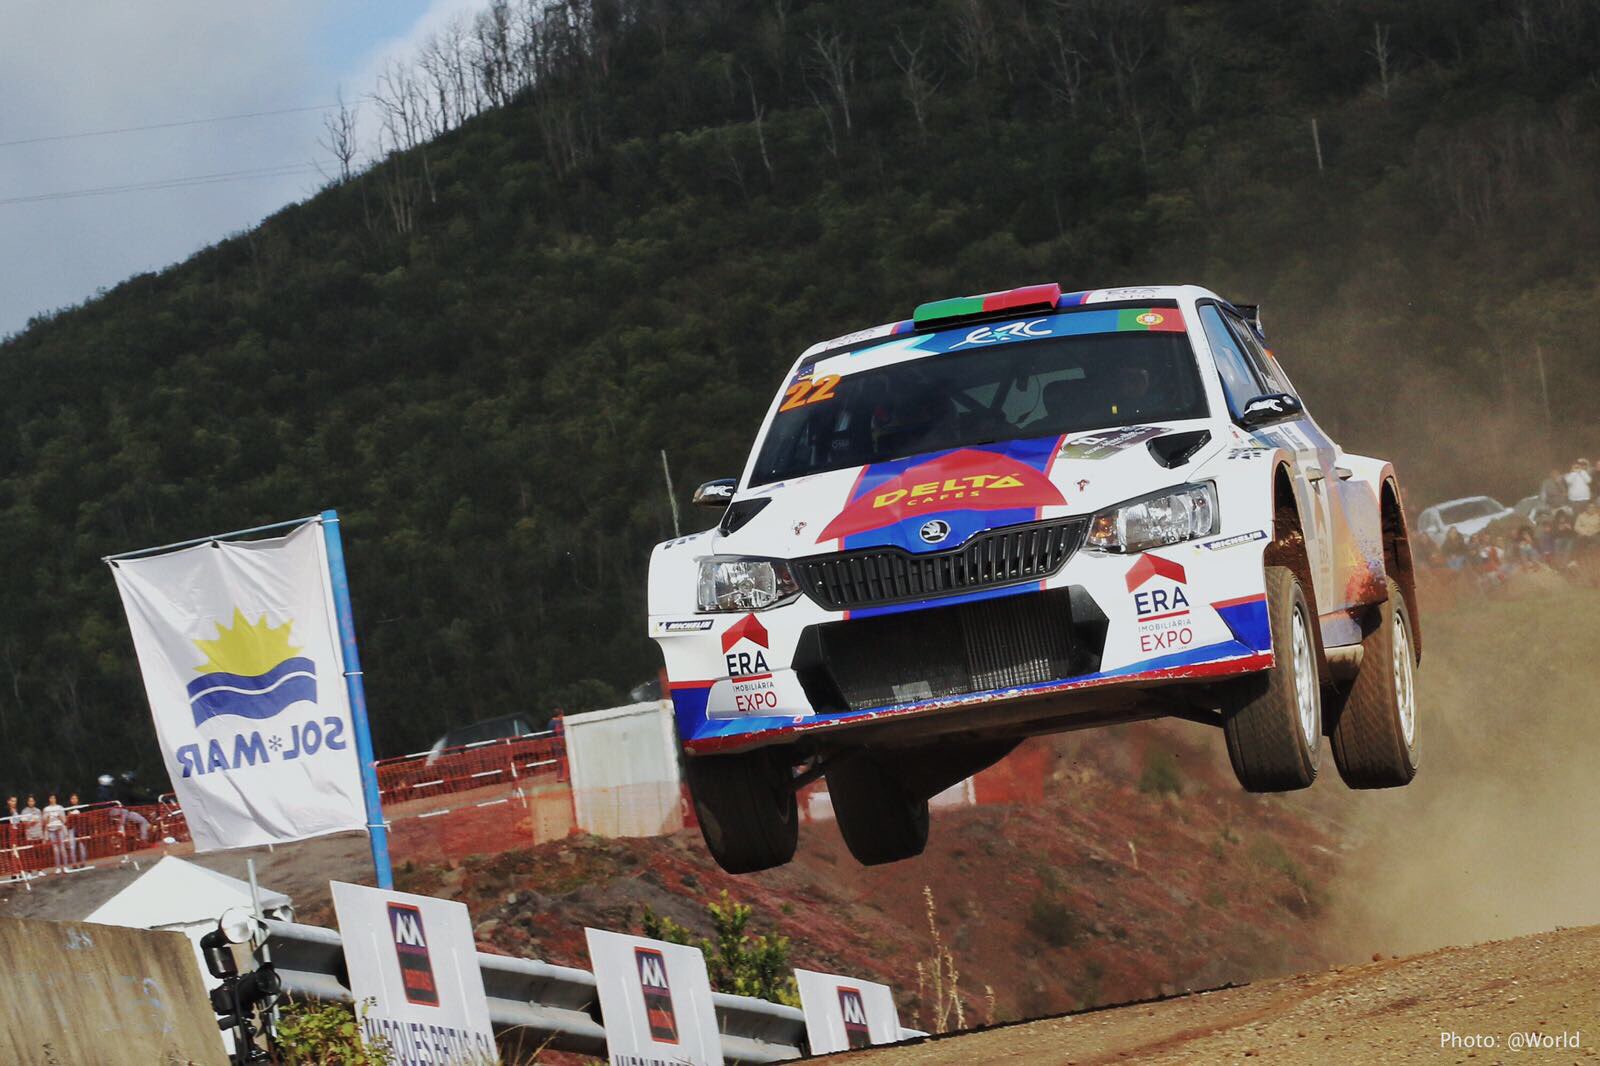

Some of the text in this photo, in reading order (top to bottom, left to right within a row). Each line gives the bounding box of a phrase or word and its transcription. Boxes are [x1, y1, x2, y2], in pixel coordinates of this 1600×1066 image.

[949, 319, 1053, 349] ERC
[778, 374, 842, 413] 22
[873, 474, 1024, 508] DELTA
[1209, 531, 1263, 550] MICHELIN
[1134, 586, 1190, 615] ERA
[668, 621, 711, 630] MICHELIN
[1140, 628, 1193, 652] EXPO
[726, 650, 770, 677] ERA
[735, 691, 777, 712] EXPO
